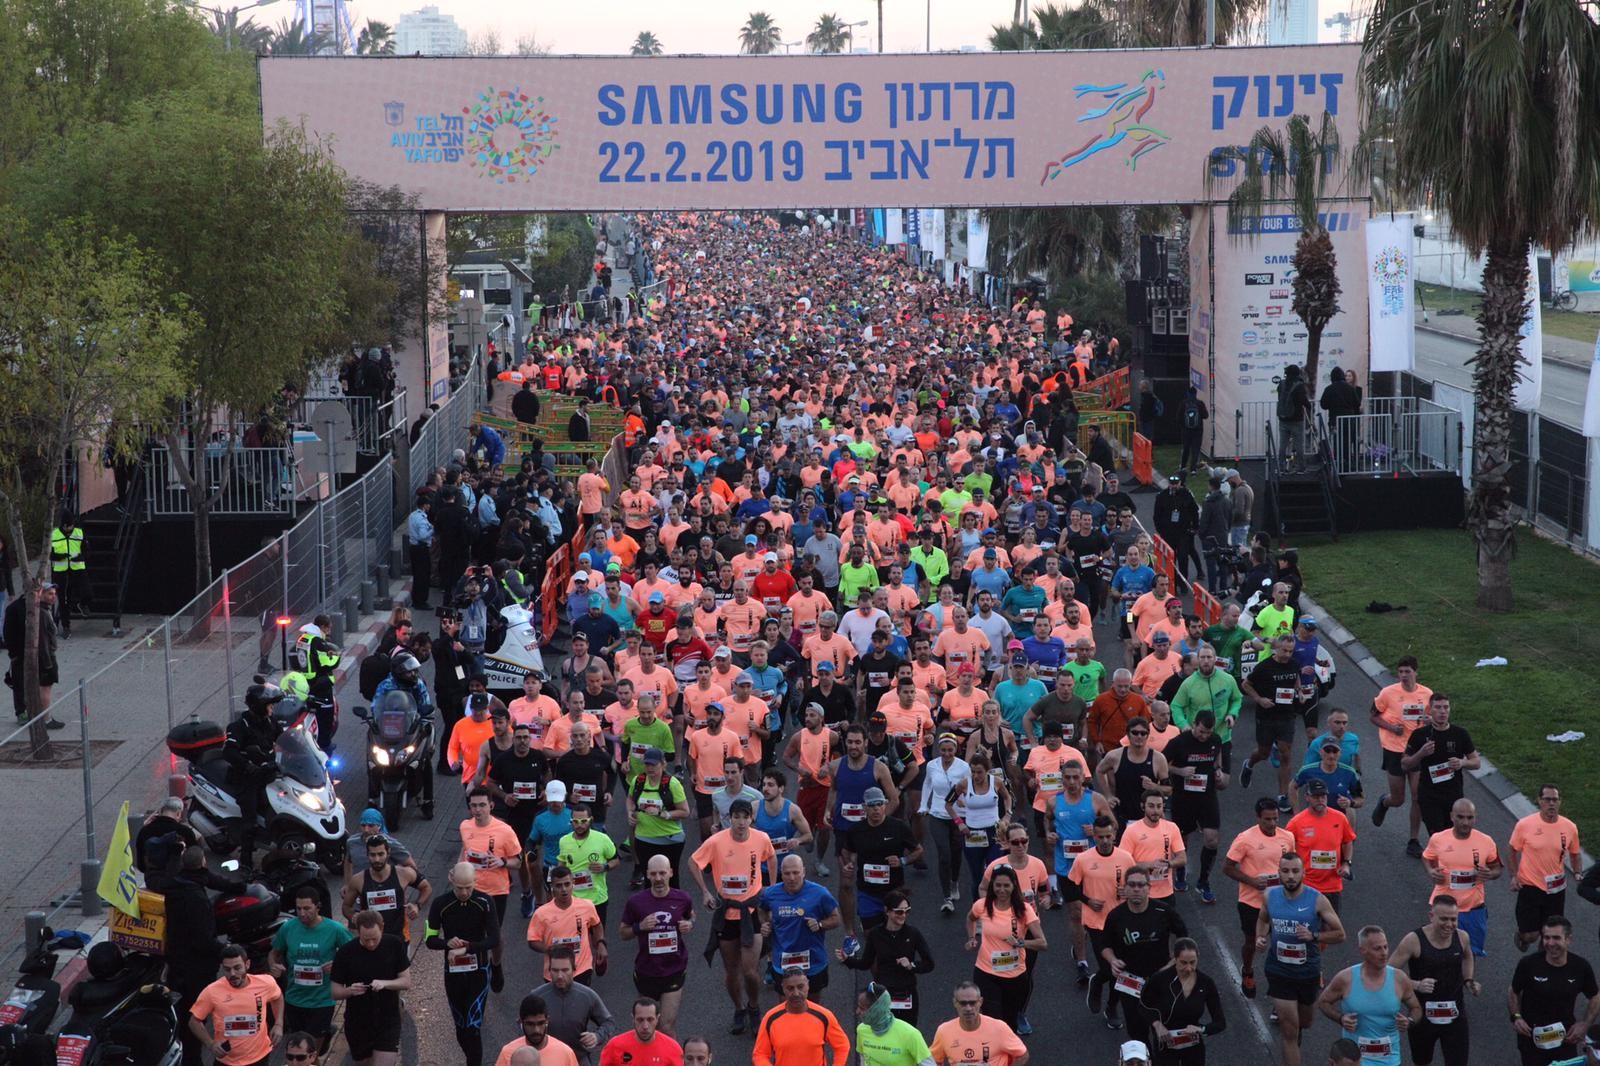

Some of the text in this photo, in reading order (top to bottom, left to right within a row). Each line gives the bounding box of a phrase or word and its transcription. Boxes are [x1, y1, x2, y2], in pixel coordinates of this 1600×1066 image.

[597, 81, 1015, 129] מרתון SAMSUNG
[1211, 73, 1344, 130] זינוק
[415, 112, 464, 131] TEL תל
[390, 132, 464, 147] AVIV אביב
[405, 148, 443, 163] YAFO
[598, 140, 804, 183] 22.2.2019
[1264, 255, 1296, 264] SAMS
[486, 672, 518, 685] POLICE
